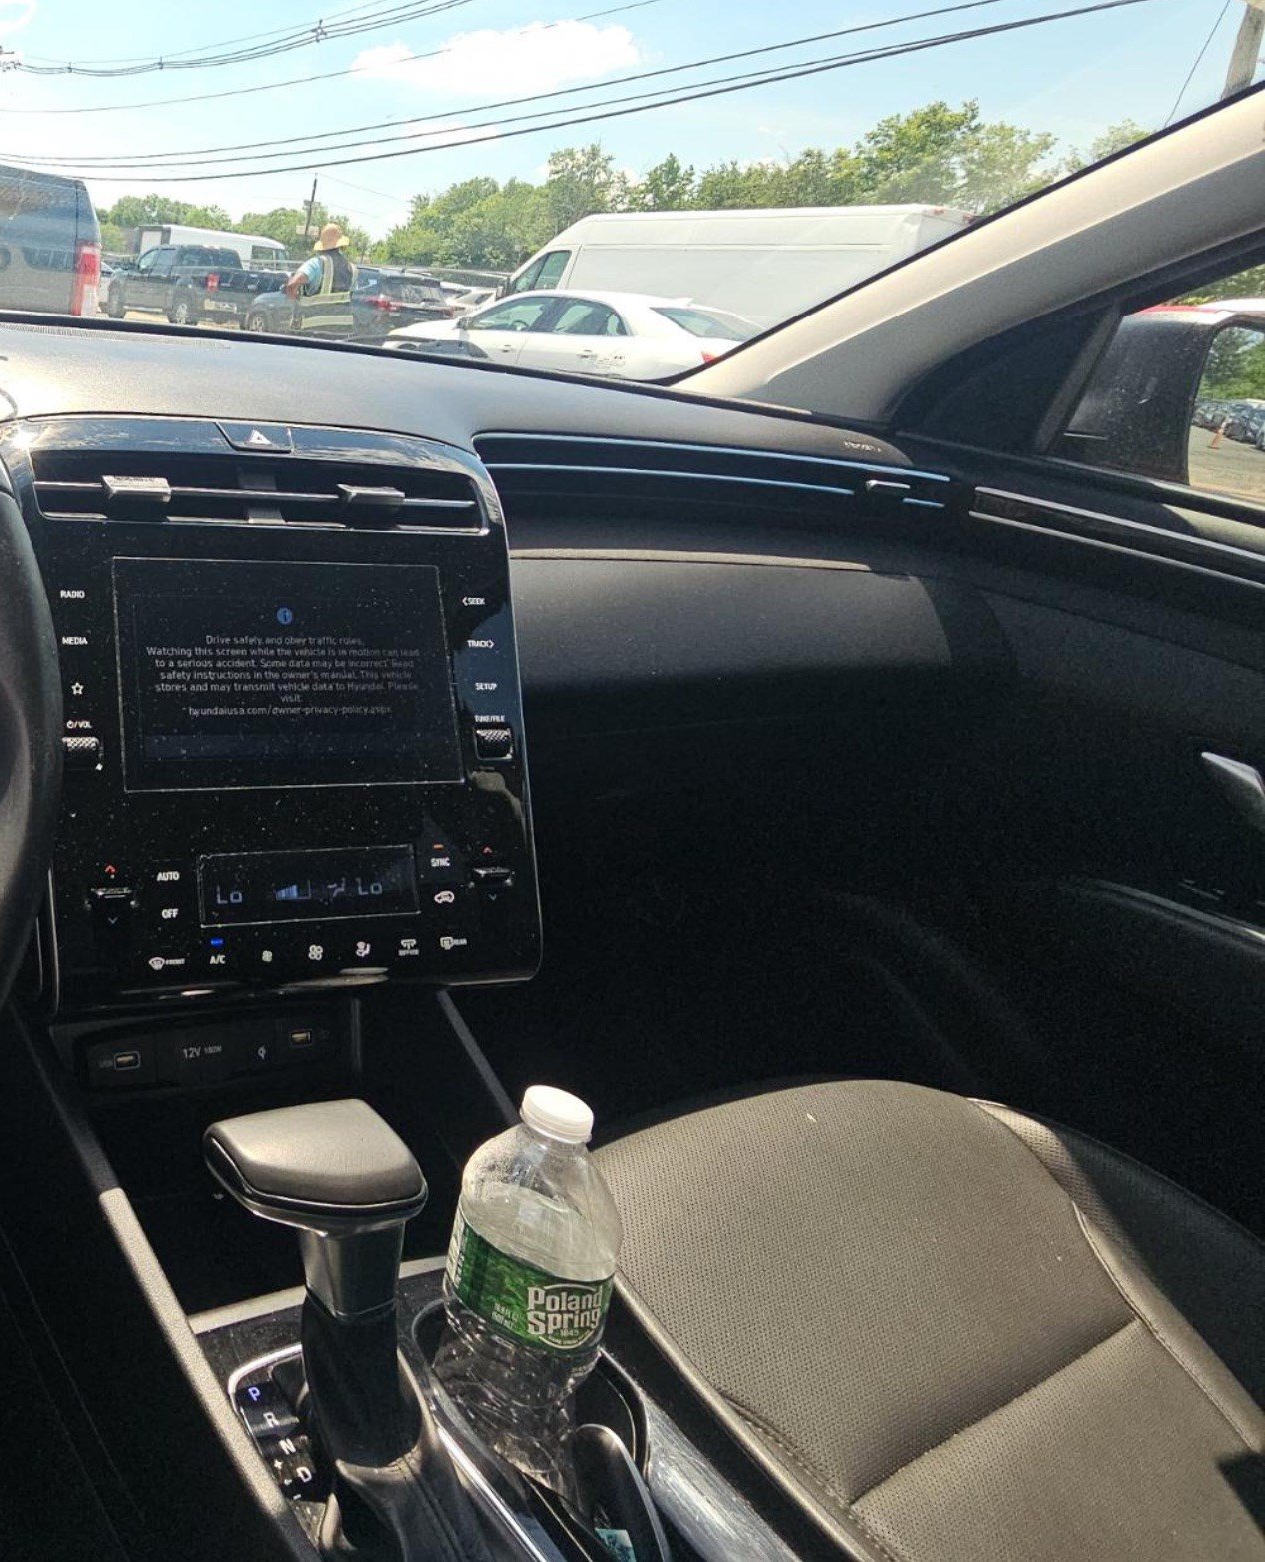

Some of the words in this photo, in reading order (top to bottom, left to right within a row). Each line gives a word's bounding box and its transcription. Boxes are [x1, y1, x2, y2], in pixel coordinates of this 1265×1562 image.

[60, 590, 85, 599] RADIO
[61, 636, 88, 645] MEDIA
[205, 635, 230, 646] Drive
[146, 647, 192, 657] Watching
[195, 647, 213, 657] this
[216, 647, 247, 657] screen
[250, 647, 275, 657] while
[277, 647, 292, 657] the
[294, 647, 325, 657] vehicle
[155, 660, 165, 668] to
[177, 660, 213, 668] serious
[260, 660, 285, 668] Some
[288, 660, 310, 668] data
[312, 660, 332, 668] may
[334, 660, 346, 668] be
[160, 671, 191, 680] safety
[193, 671, 251, 680] instructions
[254, 671, 263, 680] in
[265, 671, 280, 680] the
[282, 671, 319, 680] owner's
[360, 671, 379, 680] This
[155, 682, 187, 692] stores
[190, 682, 208, 692] and
[210, 682, 232, 692] may
[234, 682, 275, 692] transmit
[278, 682, 310, 692] vehicle
[312, 682, 334, 692] data
[336, 682, 345, 692] to
[387, 682, 418, 692] Please
[475, 682, 497, 691] SETUP
[430, 857, 450, 867] SYNC
[156, 871, 180, 881] AUTO
[161, 908, 179, 919] OFF
[209, 953, 226, 965] A/C
[183, 1046, 201, 1060] 12V
[526, 1286, 603, 1311] Poland
[527, 1308, 601, 1335] Spring
[248, 1386, 261, 1401] P
[262, 1412, 280, 1428] R
[278, 1437, 297, 1455] N
[295, 1466, 313, 1483] D
